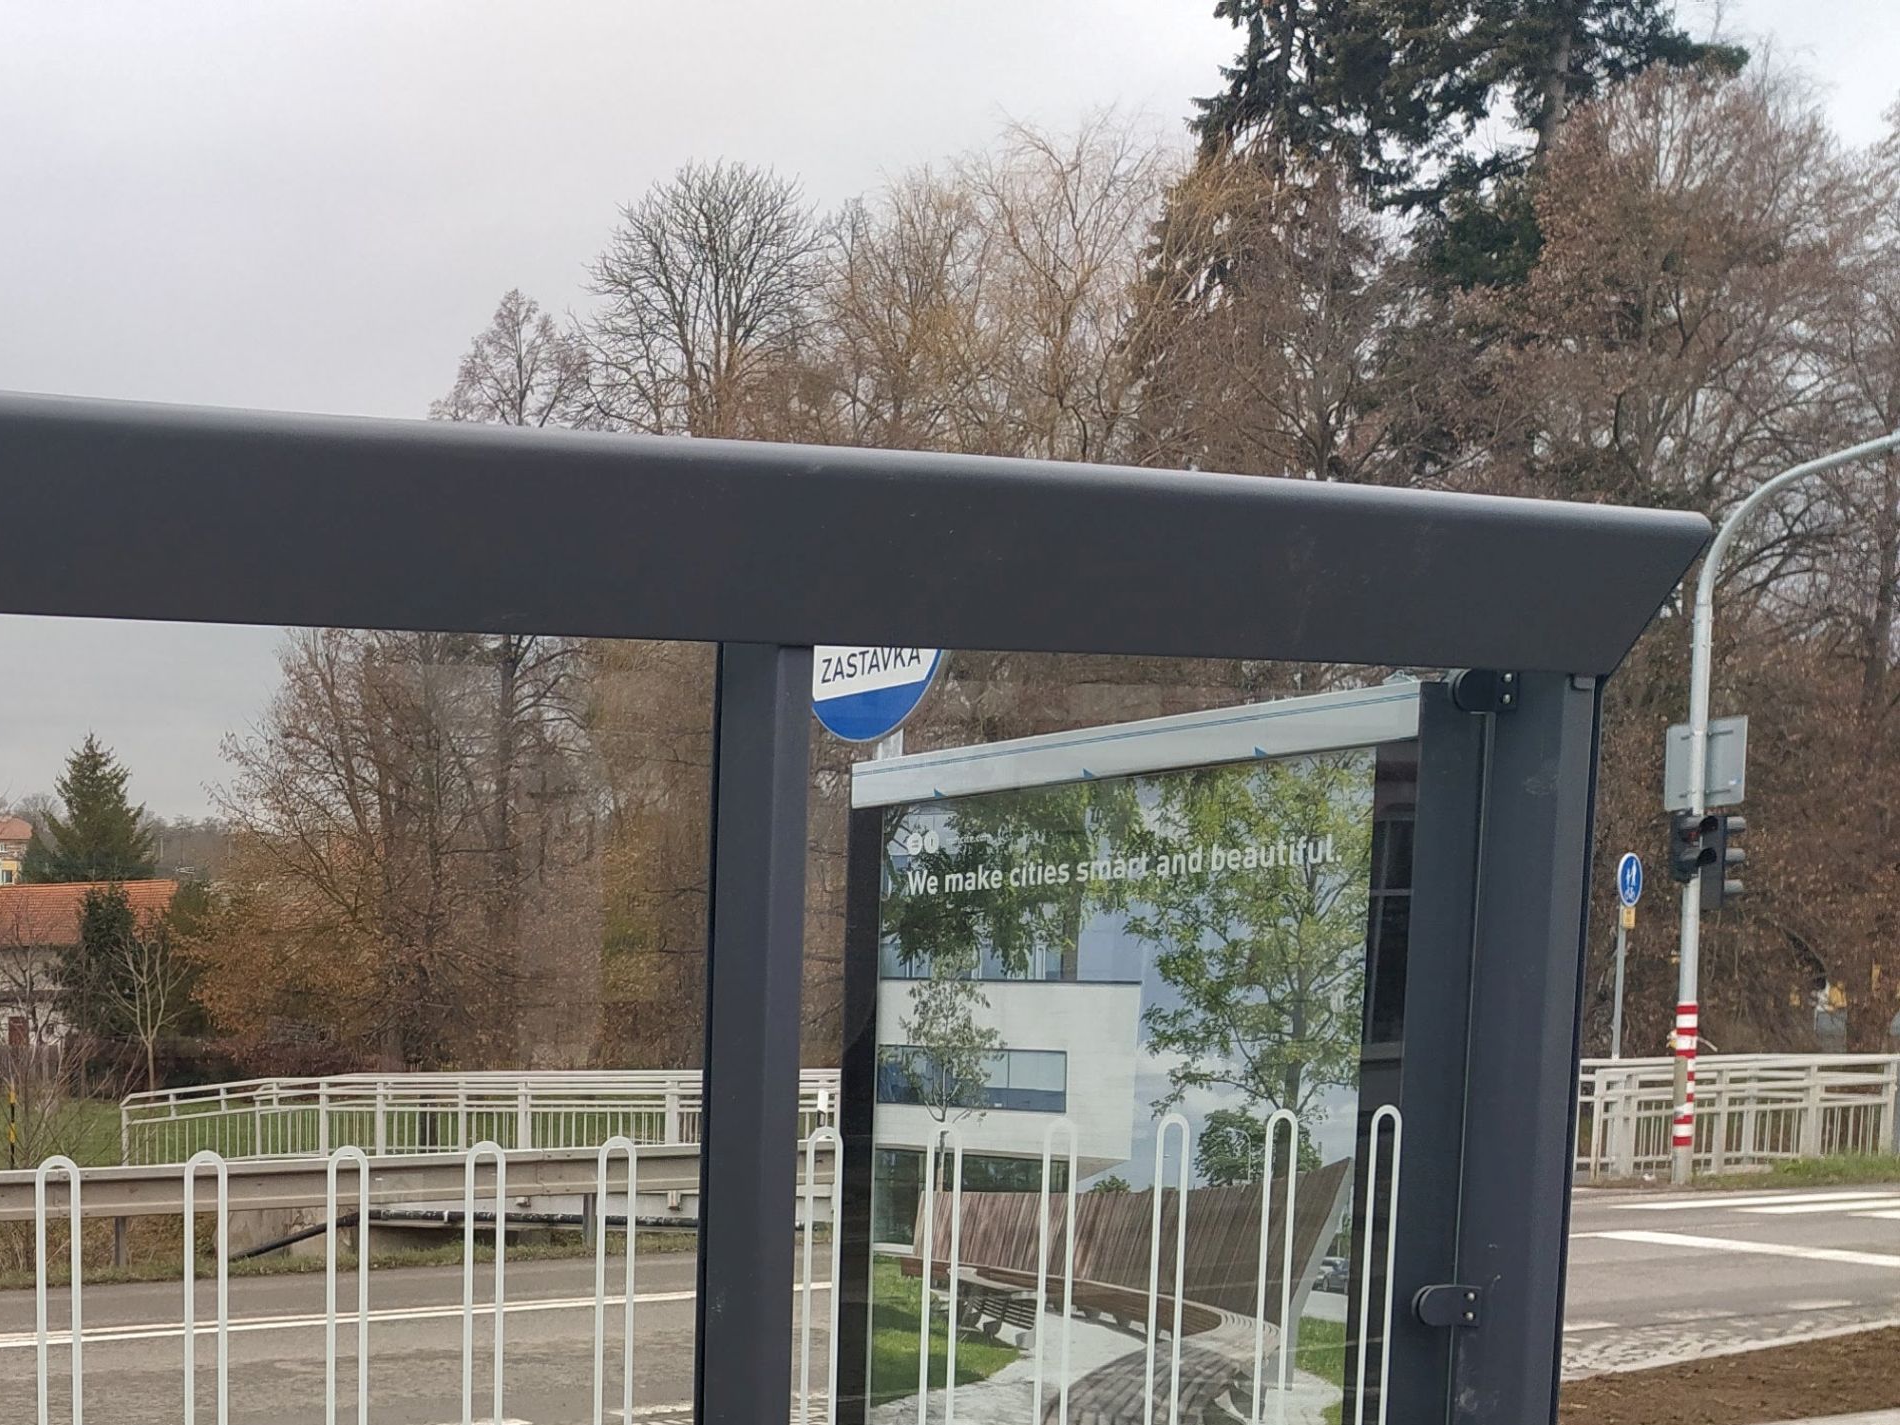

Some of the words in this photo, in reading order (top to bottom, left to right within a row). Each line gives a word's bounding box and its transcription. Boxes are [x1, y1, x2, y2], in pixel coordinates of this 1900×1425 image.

[908, 869, 938, 895] We
[944, 864, 1003, 893] make
[1009, 858, 1070, 887] cities
[1076, 851, 1149, 883] smart
[1156, 847, 1203, 877] and
[1211, 833, 1342, 872] beautiful.
